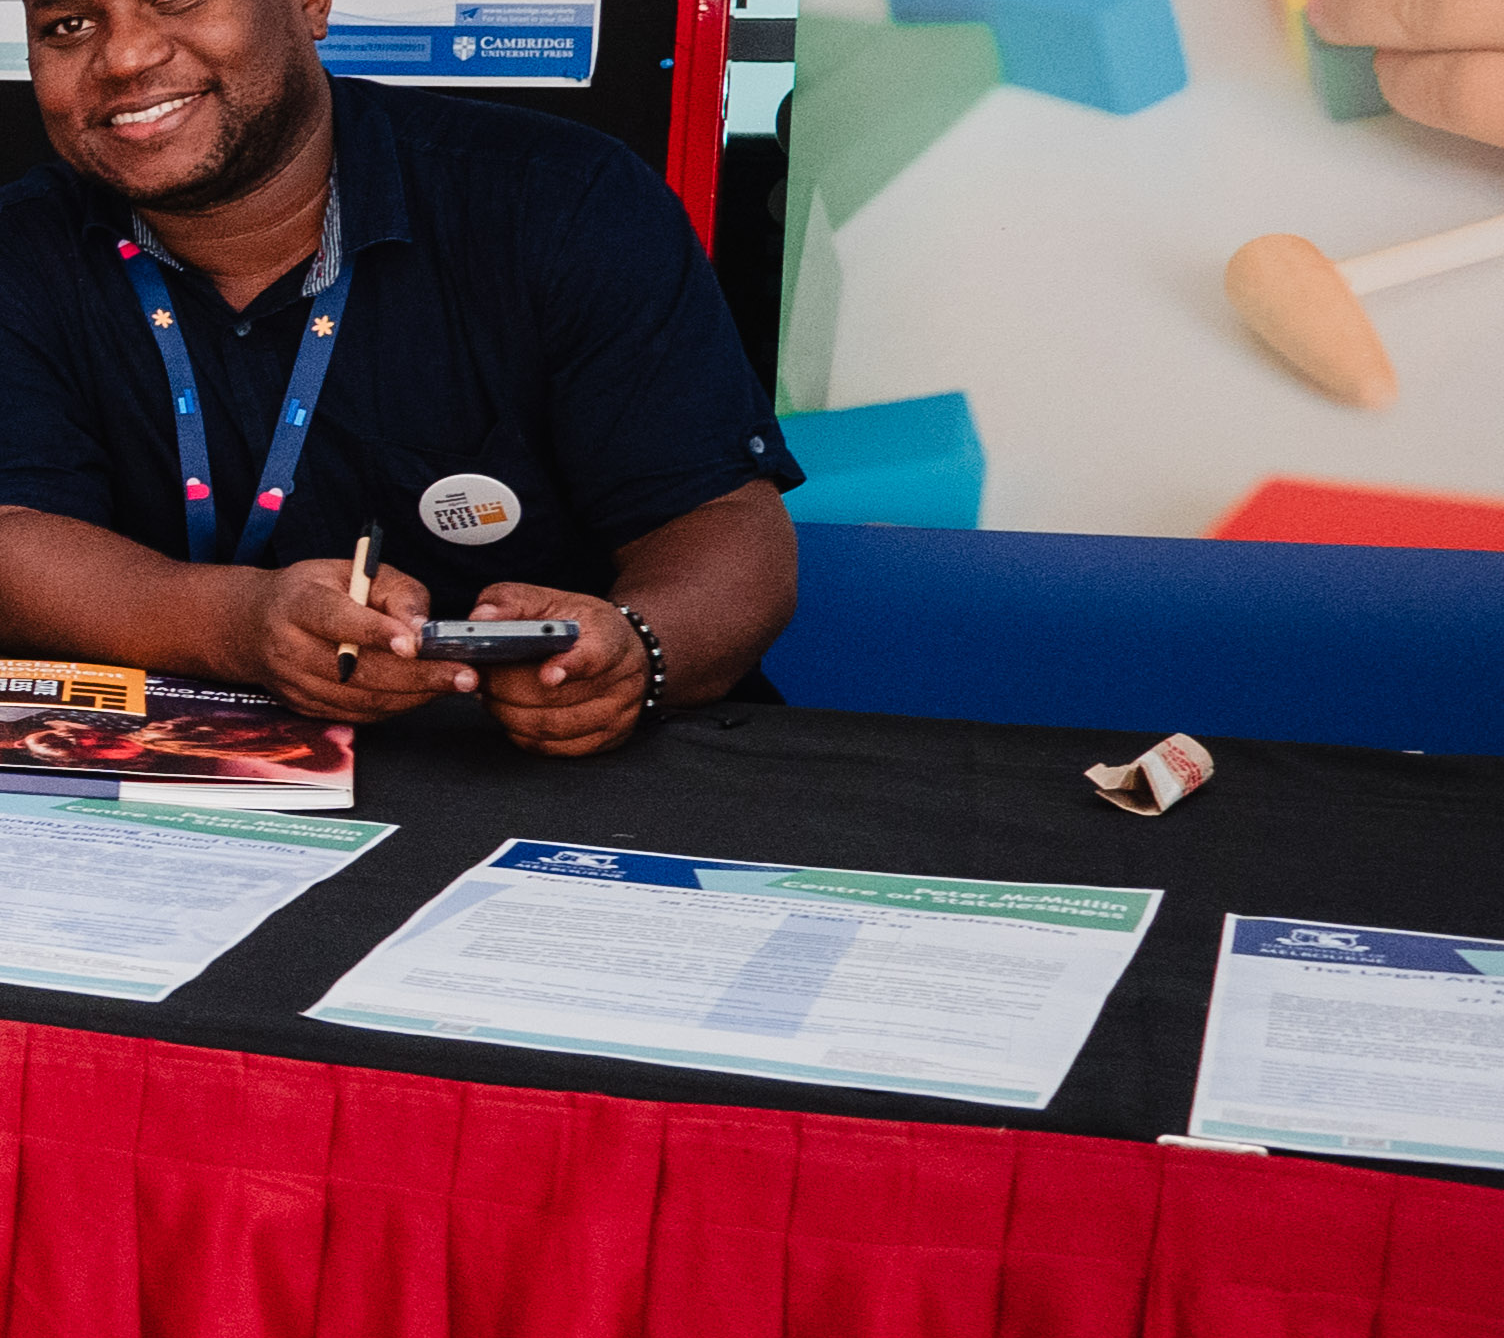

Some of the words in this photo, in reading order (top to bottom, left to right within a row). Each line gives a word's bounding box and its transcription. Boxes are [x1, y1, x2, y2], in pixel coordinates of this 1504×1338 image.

[480, 36, 574, 49] CAMBRIDGE
[481, 50, 540, 58] UNIVERSITY
[781, 880, 878, 897] Centre
[885, 892, 924, 901] on
[930, 895, 1127, 920] Statelessness
[913, 887, 992, 901] Peter
[999, 893, 1130, 913] McMullin
